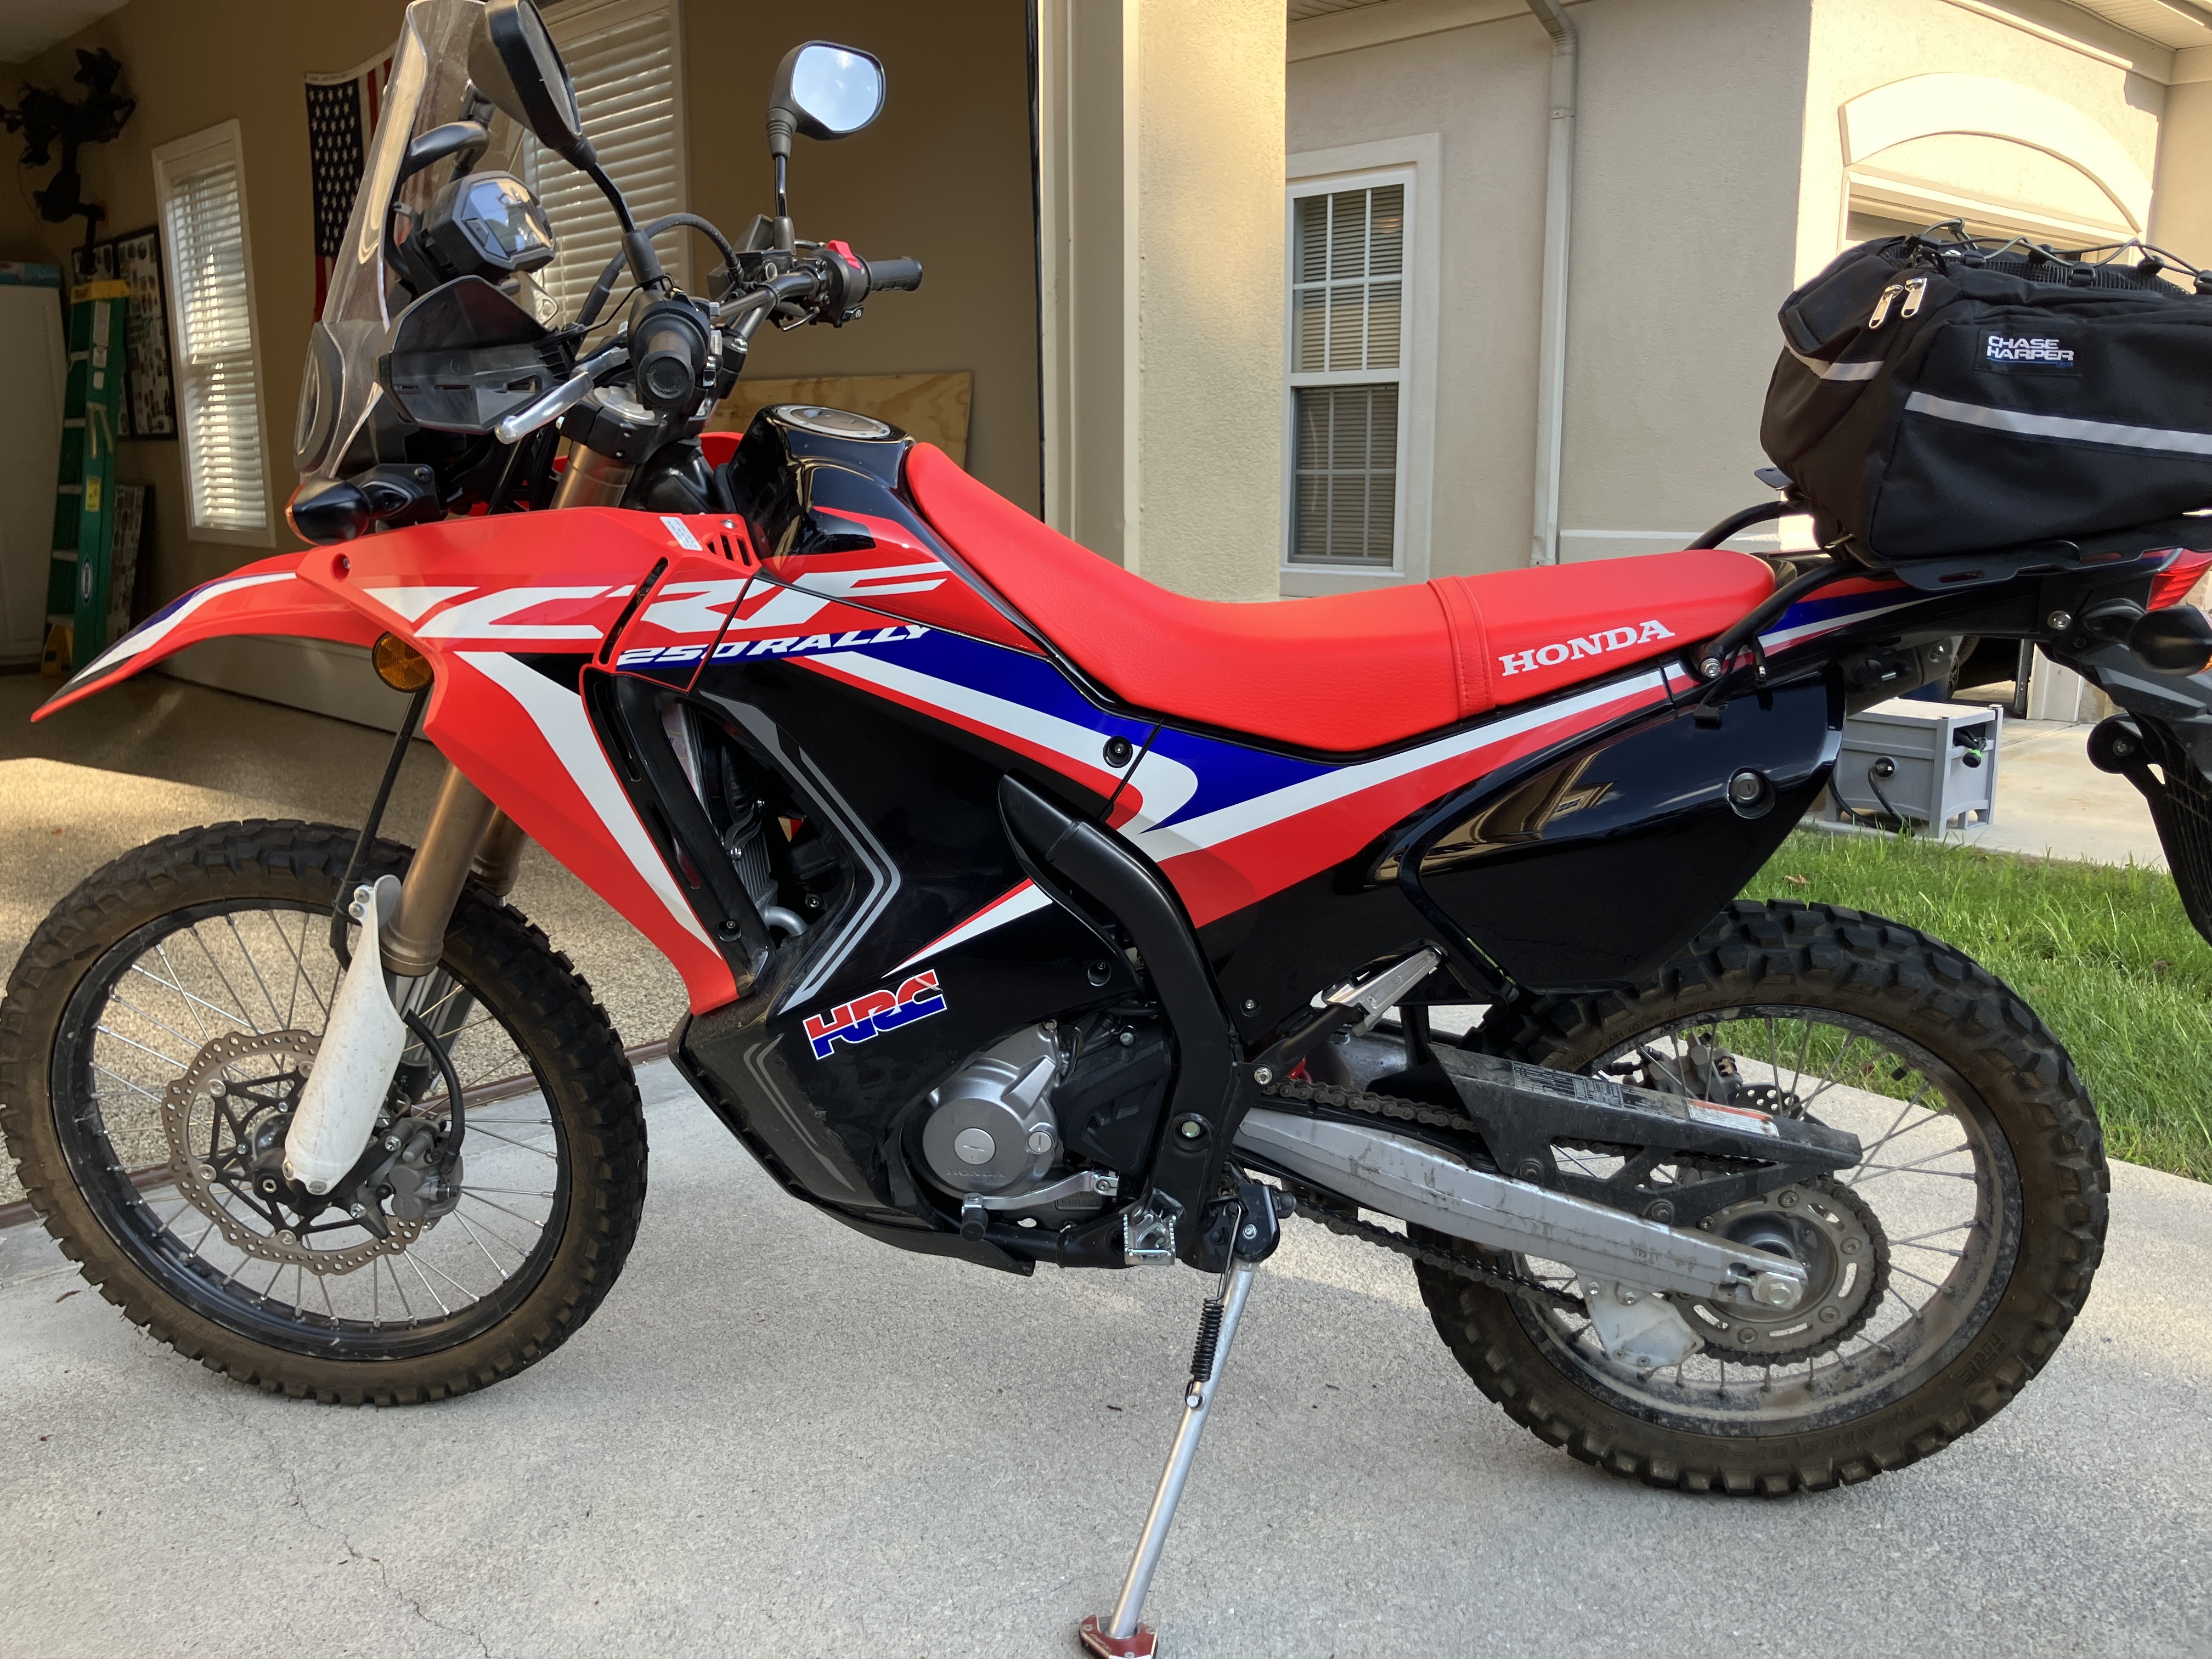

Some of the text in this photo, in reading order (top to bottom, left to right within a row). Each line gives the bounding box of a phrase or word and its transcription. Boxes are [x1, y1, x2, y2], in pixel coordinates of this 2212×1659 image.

[1987, 346, 2075, 361] HARPER
[1988, 336, 2059, 349] CHASE
[414, 562, 951, 639] CRF
[616, 625, 931, 666] 250 RALLY
[1498, 619, 1675, 677] HONDA
[802, 968, 948, 1060] HRC
[946, 1168, 1006, 1177] HONDA
[1803, 1403, 1921, 1456] TRAILS
